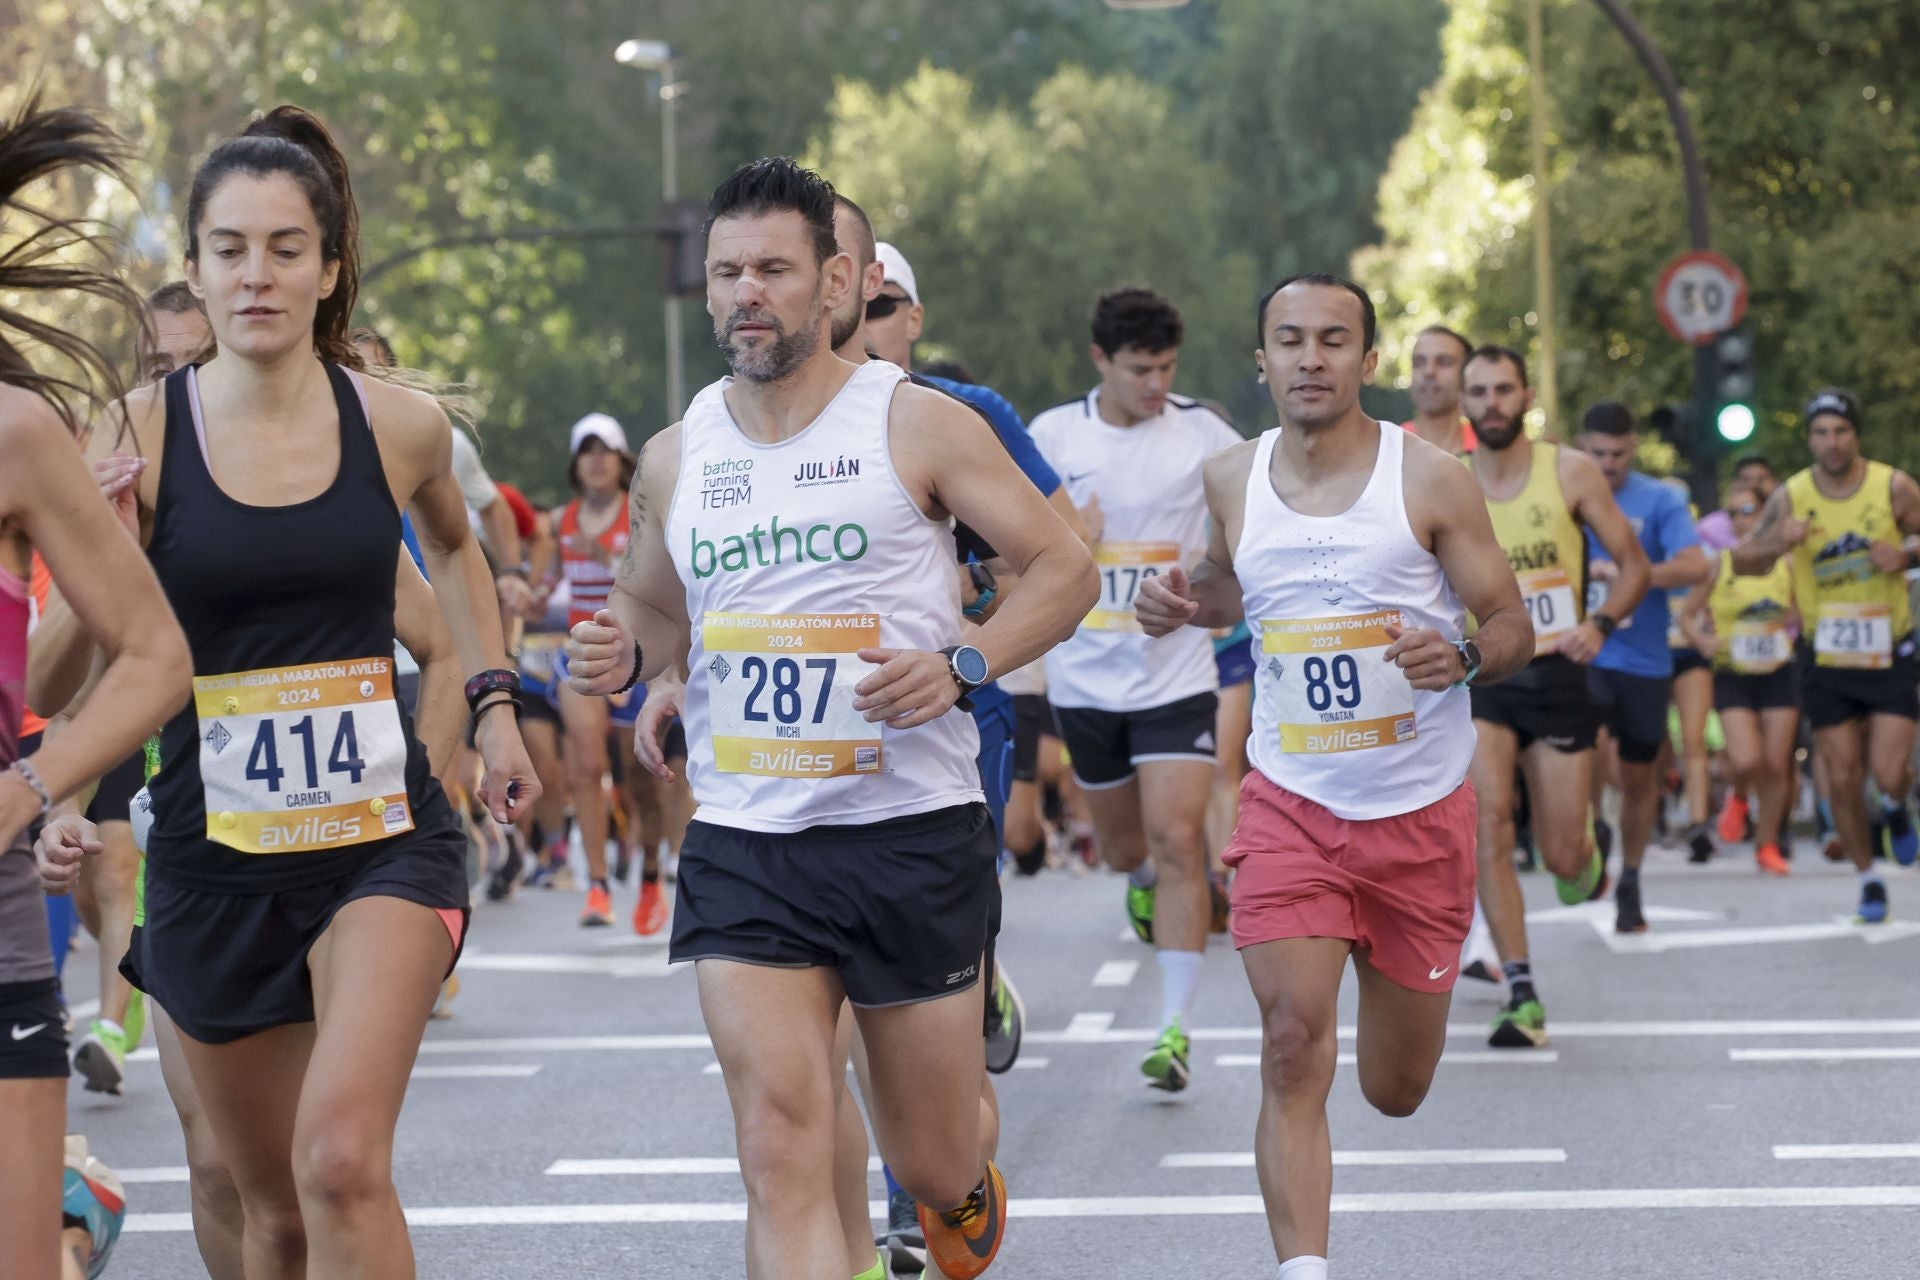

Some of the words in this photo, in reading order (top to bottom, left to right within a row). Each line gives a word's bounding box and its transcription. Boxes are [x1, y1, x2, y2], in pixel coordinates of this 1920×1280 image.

[703, 458, 754, 476] bathco
[794, 456, 860, 481] JULIÁN
[704, 474, 750, 488] running
[700, 486, 751, 510] TEAM
[691, 516, 868, 579] bathco
[1105, 567, 1157, 604] 17
[737, 617, 769, 629] MEDIA
[772, 615, 832, 629] MARATÓN
[833, 614, 875, 628] AVILÉS
[1314, 619, 1362, 633] MARATÓN
[1364, 612, 1398, 628] AVILÉS
[768, 635, 803, 648] 2024
[1311, 636, 1342, 648] 2024
[1831, 618, 1873, 649] 231
[240, 672, 280, 687] MEDIA
[283, 664, 346, 683] MARATÓN
[349, 659, 388, 677] AVILÉS
[1304, 654, 1361, 711] 89
[278, 687, 320, 705] 2024
[742, 656, 837, 724] 287
[1319, 710, 1355, 723] YONATAN
[776, 725, 800, 738] MICHI
[1306, 728, 1380, 751] avilés
[245, 711, 366, 792] 414
[750, 748, 835, 772] avilés
[286, 790, 332, 808] CARMEN
[258, 815, 362, 847] avilés
[946, 965, 976, 984] 2XL
